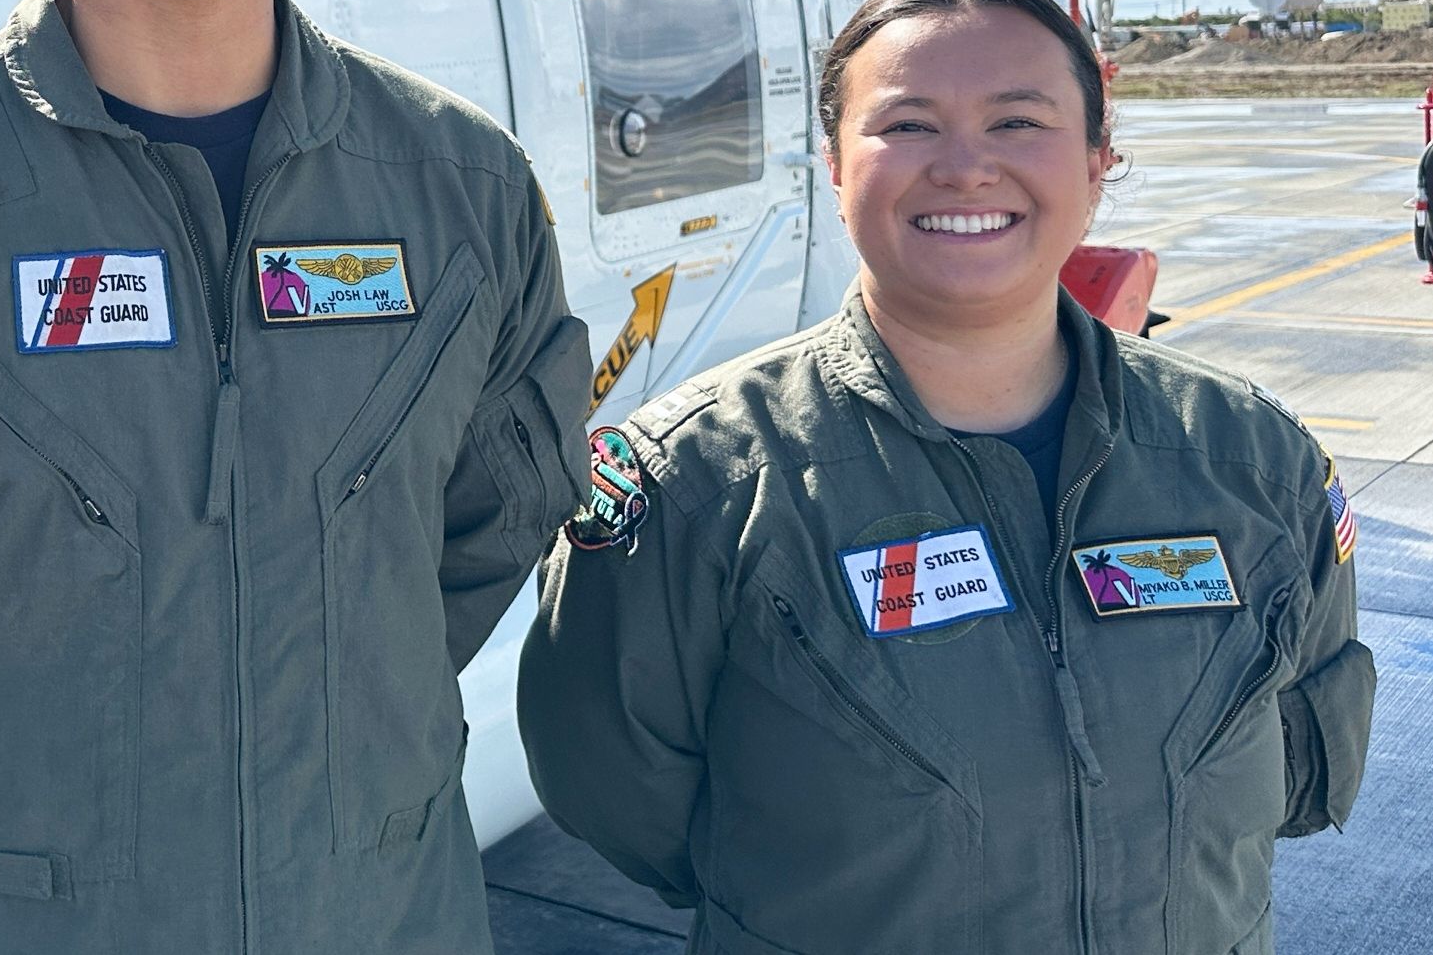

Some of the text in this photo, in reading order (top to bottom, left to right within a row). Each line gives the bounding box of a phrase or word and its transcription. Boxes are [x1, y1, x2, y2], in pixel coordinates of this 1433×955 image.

[38, 273, 147, 296] UNITED STATES
[327, 289, 390, 302] JOSH LAW
[43, 304, 149, 326] COAST GUARD
[313, 300, 409, 315] AST USCG
[593, 320, 640, 401] CUE
[860, 547, 980, 584] UNITED STATES
[876, 578, 988, 614] COAST GUARD
[1138, 579, 1230, 594] MIYAKO B. MILLER
[1143, 590, 1233, 605] LT USCG
